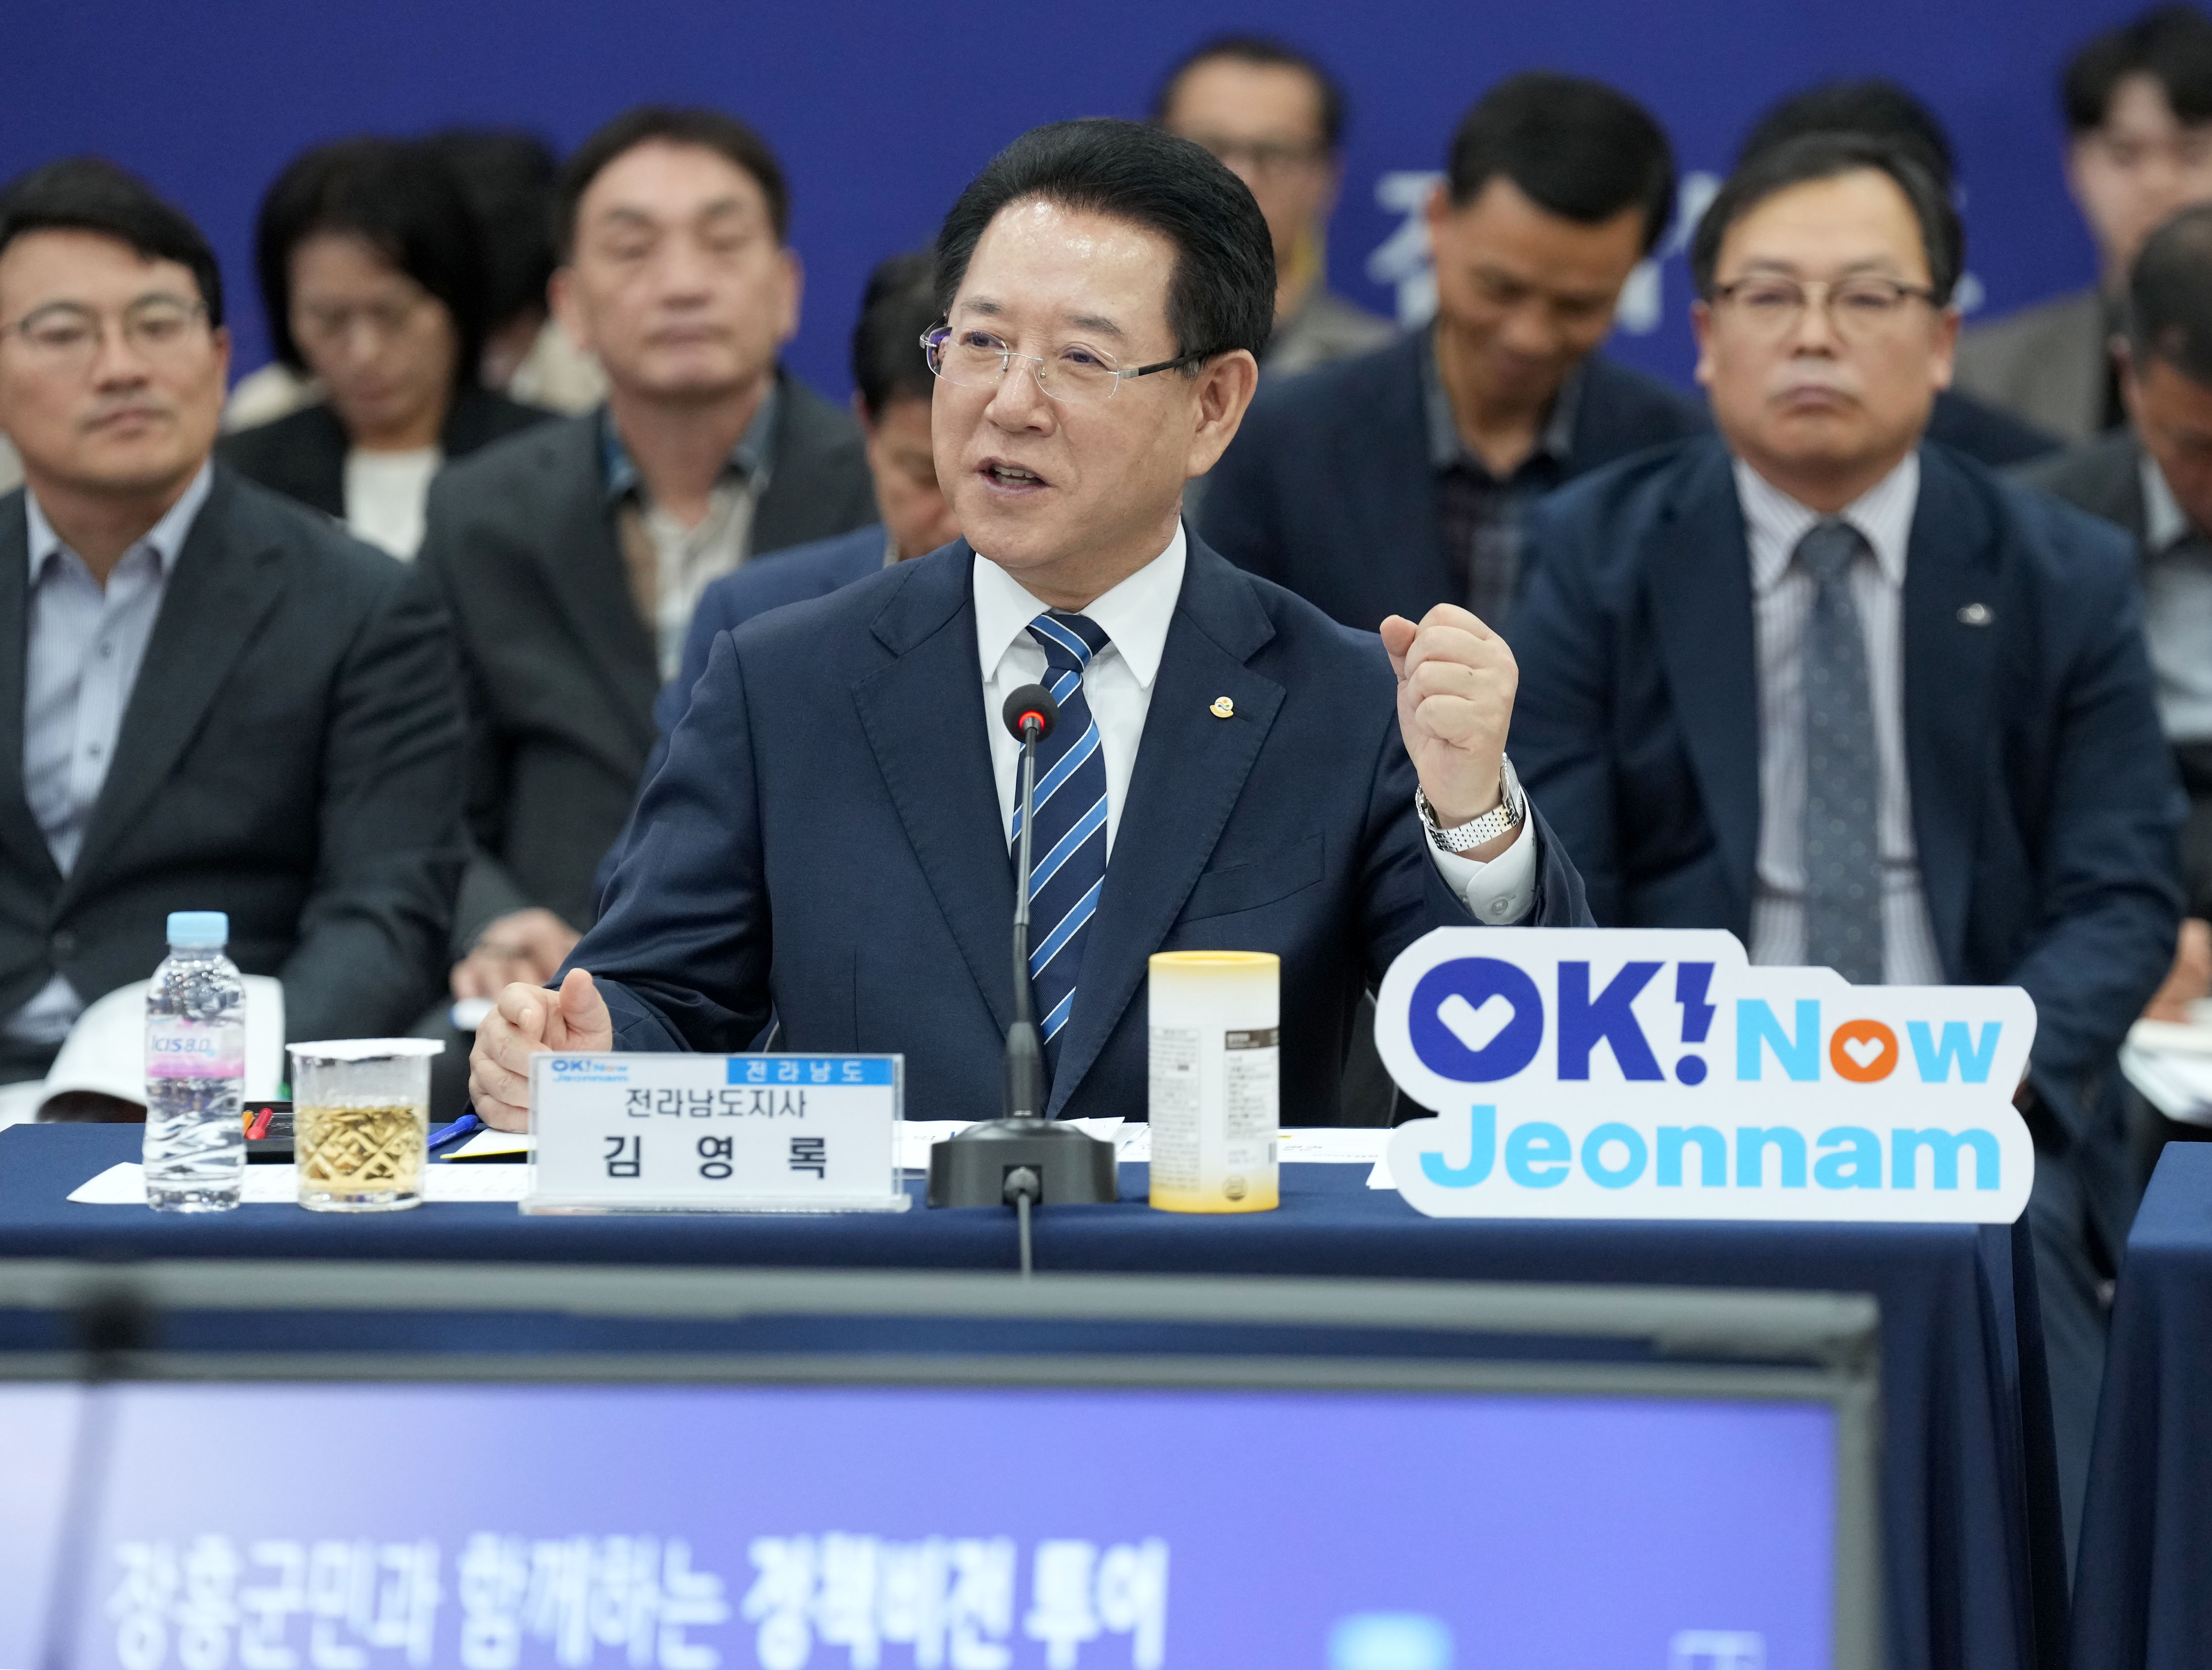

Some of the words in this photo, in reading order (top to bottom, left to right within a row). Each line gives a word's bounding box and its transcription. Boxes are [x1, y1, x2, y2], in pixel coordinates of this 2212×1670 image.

[1408, 956, 1717, 1087] OK!
[1735, 998, 2004, 1084] Now
[625, 1089, 807, 1118] 전라남도지사
[1419, 1104, 2001, 1191] Jeonnam
